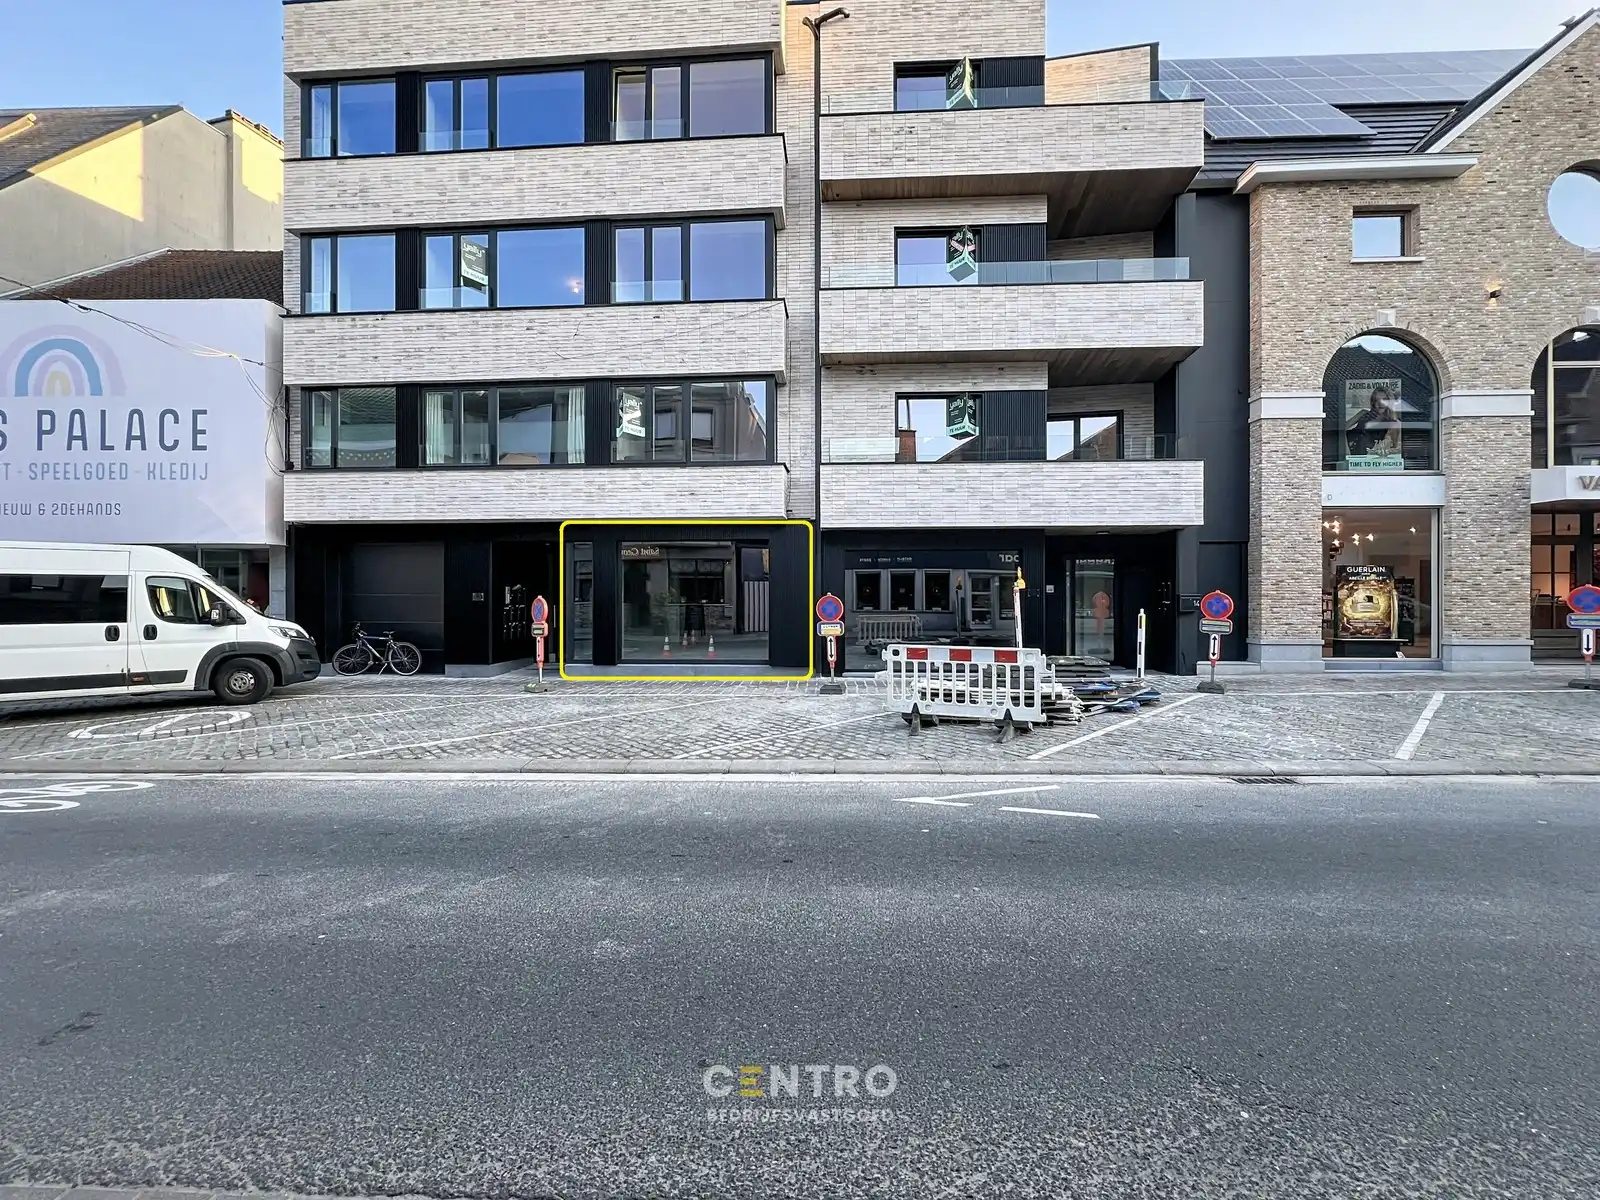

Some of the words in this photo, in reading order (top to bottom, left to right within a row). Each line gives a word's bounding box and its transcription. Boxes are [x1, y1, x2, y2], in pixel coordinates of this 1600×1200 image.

[36, 408, 208, 452] PALACE
[28, 462, 128, 481] SPEELGOED
[148, 462, 208, 481] KLEDIJ
[38, 502, 46, 516] &
[51, 502, 121, 516] 2DEHANDS
